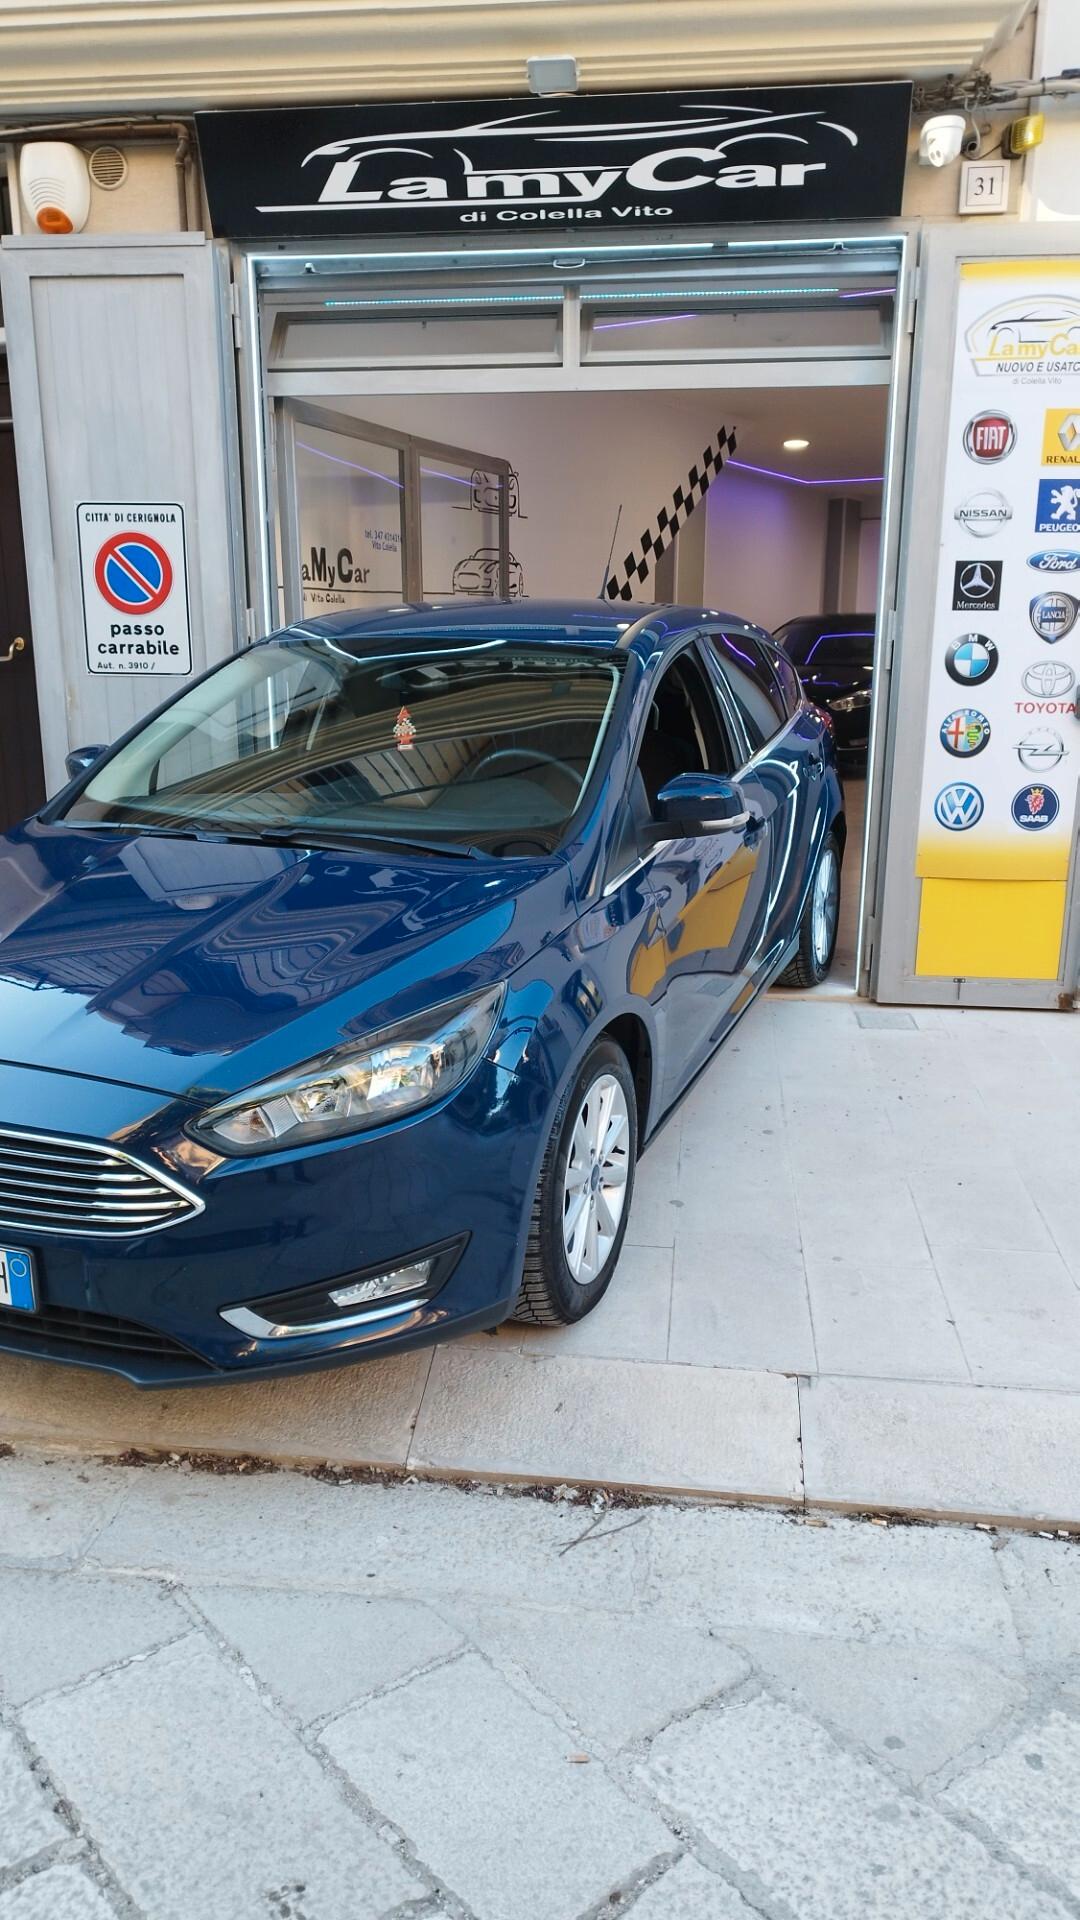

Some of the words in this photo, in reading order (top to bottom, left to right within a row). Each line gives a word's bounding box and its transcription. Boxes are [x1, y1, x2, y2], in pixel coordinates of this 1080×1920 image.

[974, 177, 996, 196] 31
[459, 211, 487, 223] di
[496, 208, 602, 221] Colella
[611, 205, 673, 218] Vito
[996, 362, 1034, 373] NUOVO
[1036, 362, 1044, 372] E
[1047, 375, 1062, 385] Vito
[976, 426, 1007, 450] FIAT
[114, 512, 124, 522] DI
[126, 512, 176, 523] CERIGNOLA
[959, 509, 1008, 518] NISSAN
[1039, 523, 1080, 532] PEUGEO
[1039, 552, 1078, 569] Ford
[956, 601, 996, 610] Mercedes
[1041, 610, 1066, 619] LANCIA
[110, 624, 165, 638] passo
[97, 640, 180, 655] carrabile
[952, 634, 995, 651] BMW
[97, 662, 115, 670] Aut.
[128, 662, 149, 670] 3910
[1014, 702, 1076, 714] TOYOTA
[964, 709, 990, 735] ROMEO
[1019, 815, 1049, 823] SAAB
